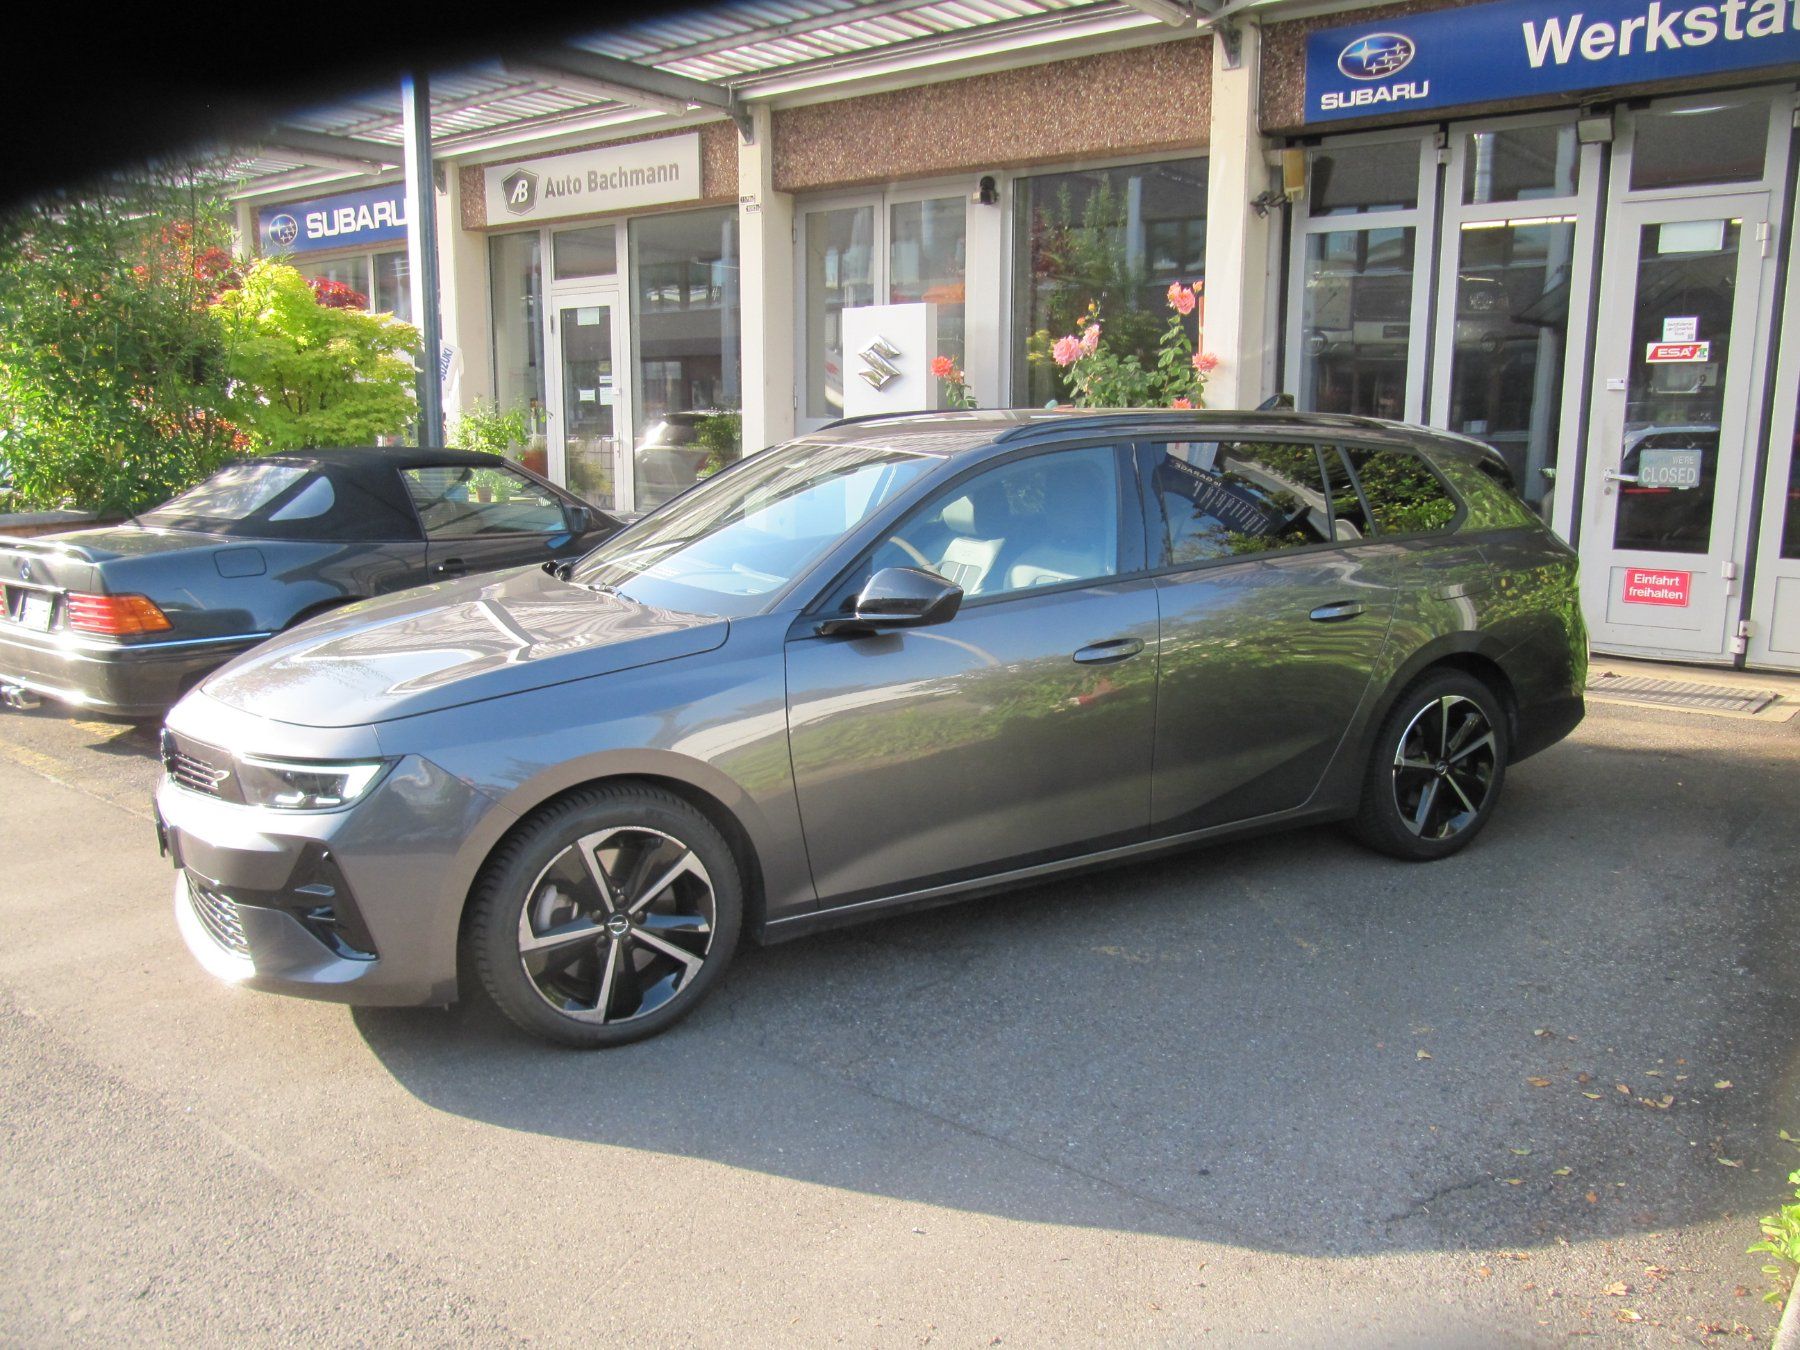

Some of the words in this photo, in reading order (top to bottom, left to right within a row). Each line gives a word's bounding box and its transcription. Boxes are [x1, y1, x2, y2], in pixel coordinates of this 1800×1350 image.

[1320, 80, 1429, 110] SUBARU
[544, 177, 582, 199] Auto
[587, 162, 680, 193] Bachmann
[1641, 466, 1696, 484] CLOSED
[1634, 573, 1680, 586] Einfahrt
[1629, 586, 1683, 600] freihalten
